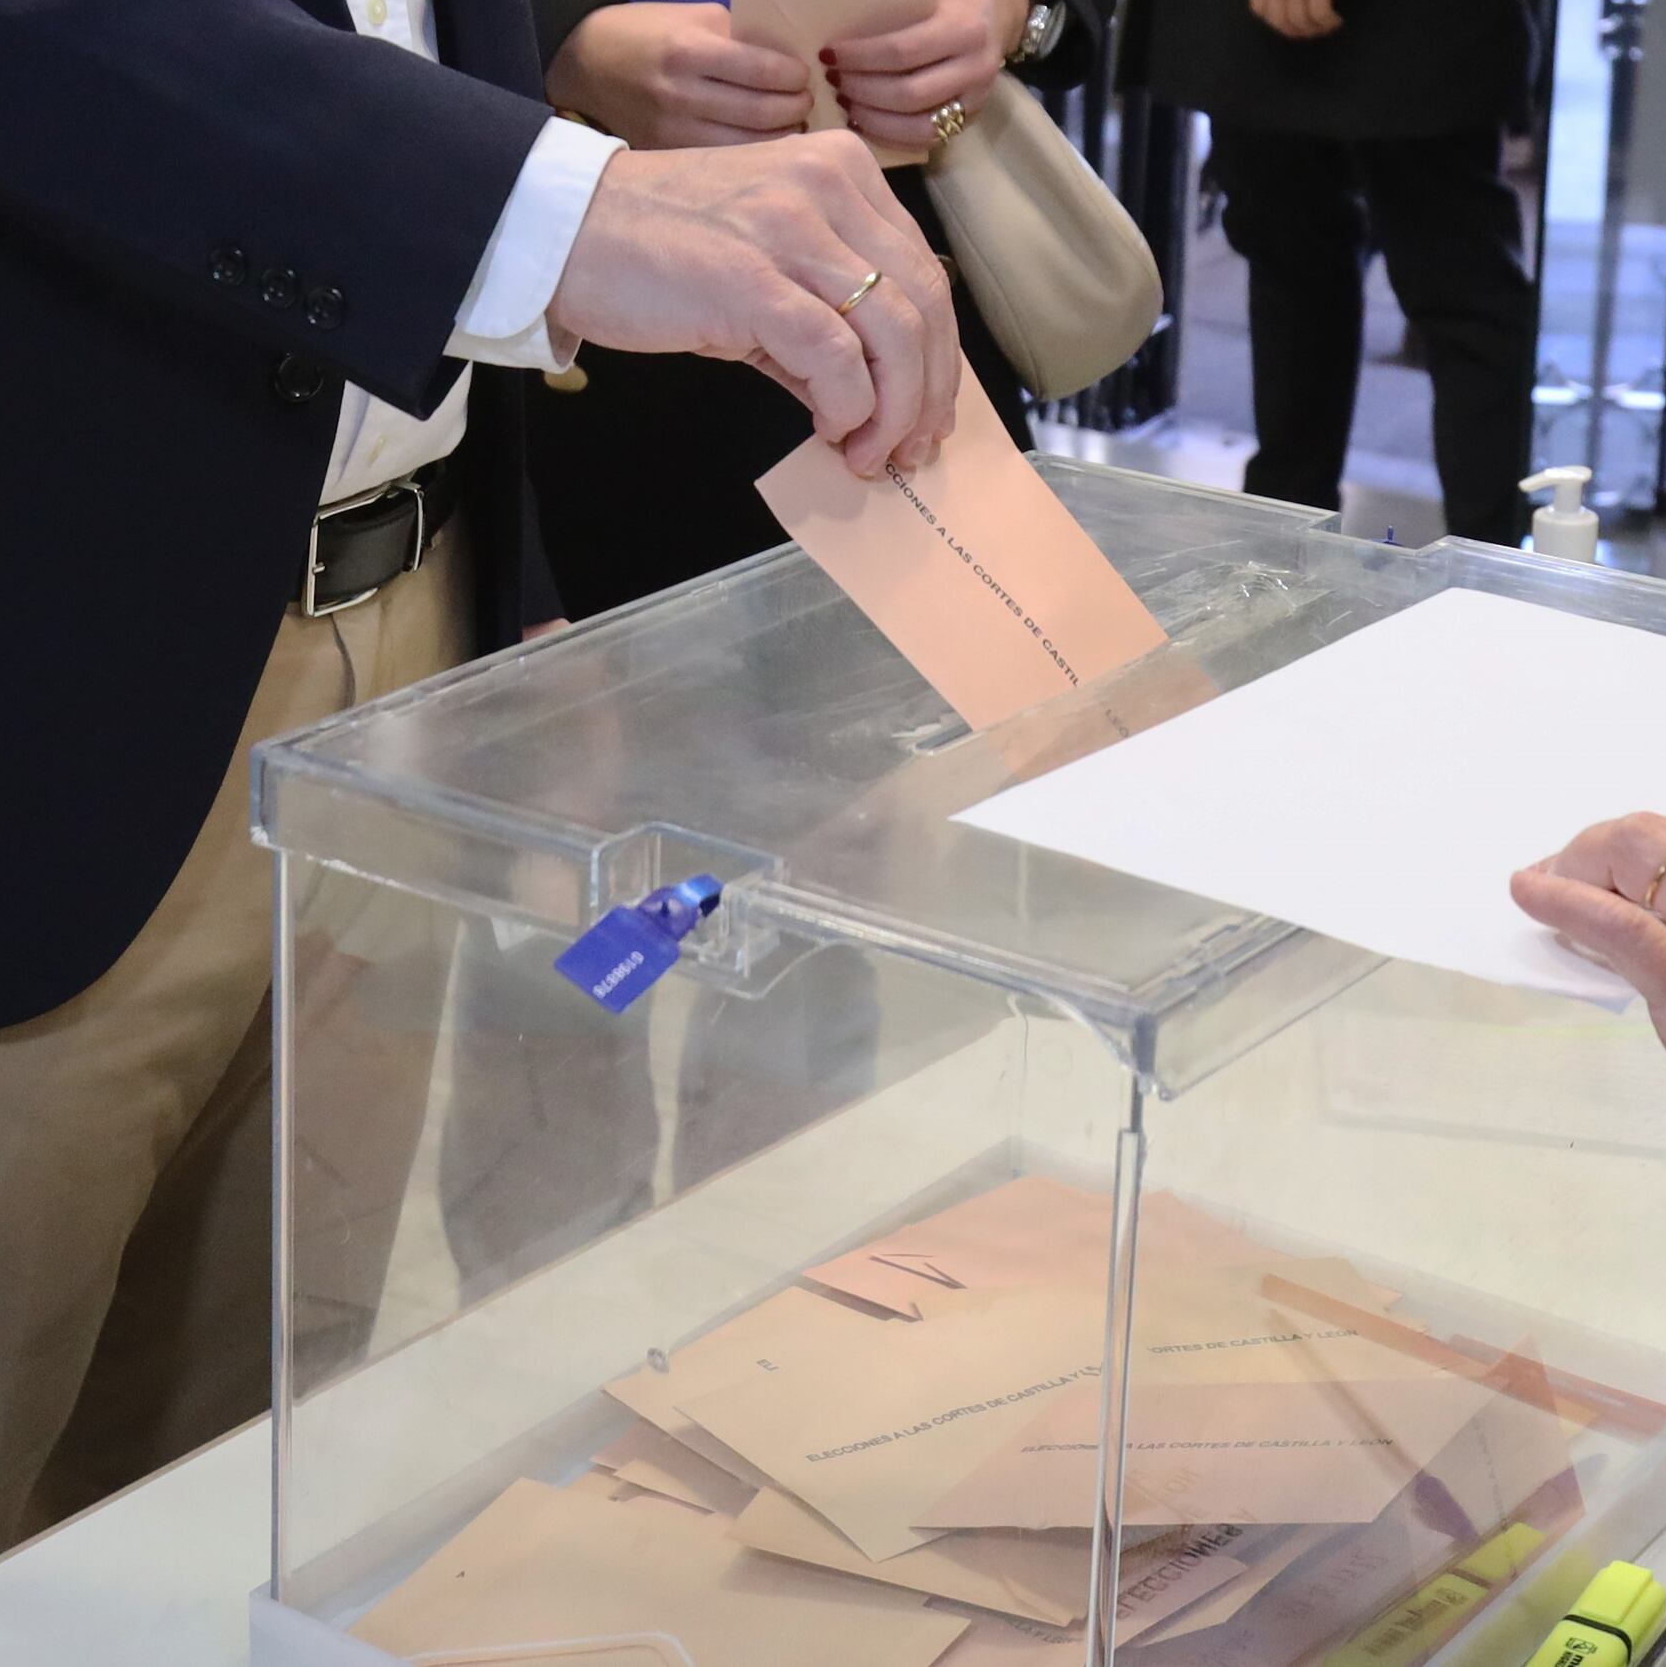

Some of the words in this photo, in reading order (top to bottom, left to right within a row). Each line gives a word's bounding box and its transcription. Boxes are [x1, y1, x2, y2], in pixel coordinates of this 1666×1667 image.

[935, 526, 946, 537] A
[947, 537, 973, 564] LAS
[973, 564, 1023, 617] CORTES
[1023, 617, 1043, 639] DE
[1205, 1341, 1228, 1350] DE
[1229, 1333, 1302, 1348] CASTILLA
[805, 1434, 893, 1462] ELECCIONES
[893, 1431, 906, 1440] A
[903, 1421, 932, 1436] LAS
[932, 1403, 987, 1426] CORTES
[986, 1396, 1009, 1410] DE
[1006, 1376, 1072, 1403] CASTILLA
[1136, 1441, 1167, 1451] LAS
[1168, 1441, 1231, 1450] CORTES
[1233, 1440, 1255, 1449] DE
[1258, 1438, 1331, 1449] CASTILLA
